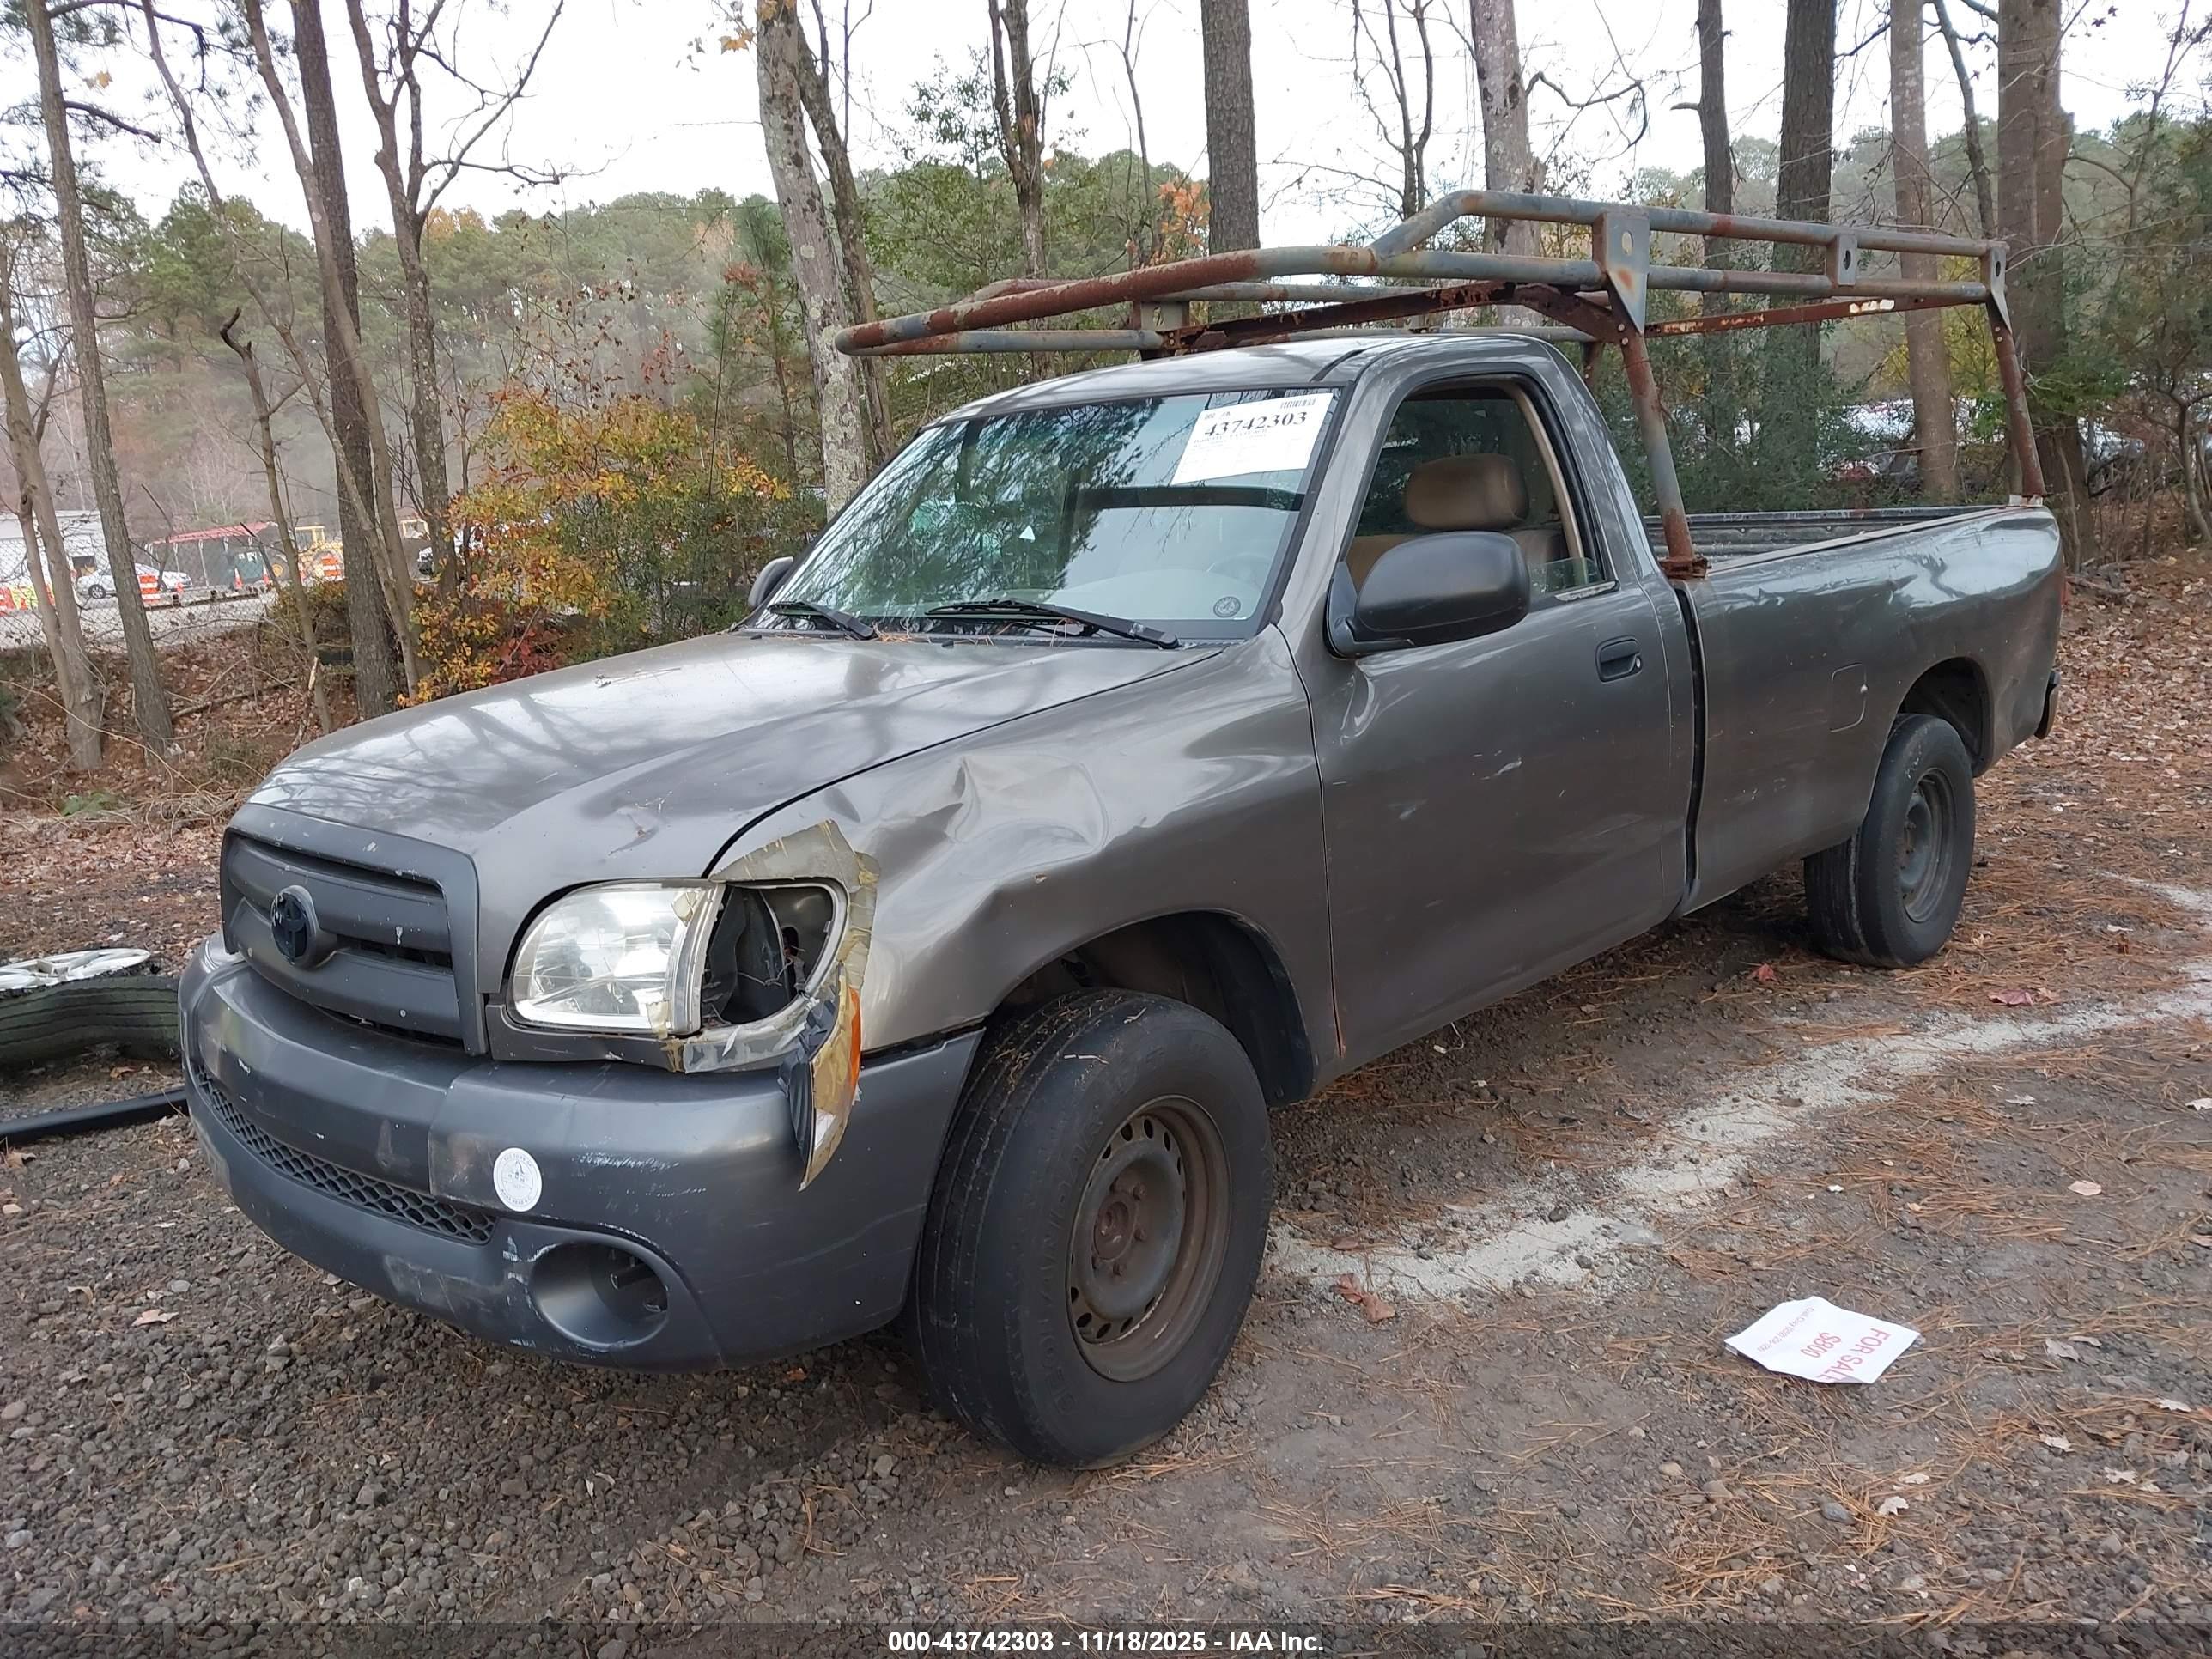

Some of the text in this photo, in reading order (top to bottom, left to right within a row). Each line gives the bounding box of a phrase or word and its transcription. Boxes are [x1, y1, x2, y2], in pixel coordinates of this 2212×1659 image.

[1205, 412, 1307, 436] 43742303
[1800, 1332, 1842, 1358] $800
[1816, 1328, 1891, 1382] FOR SALE
